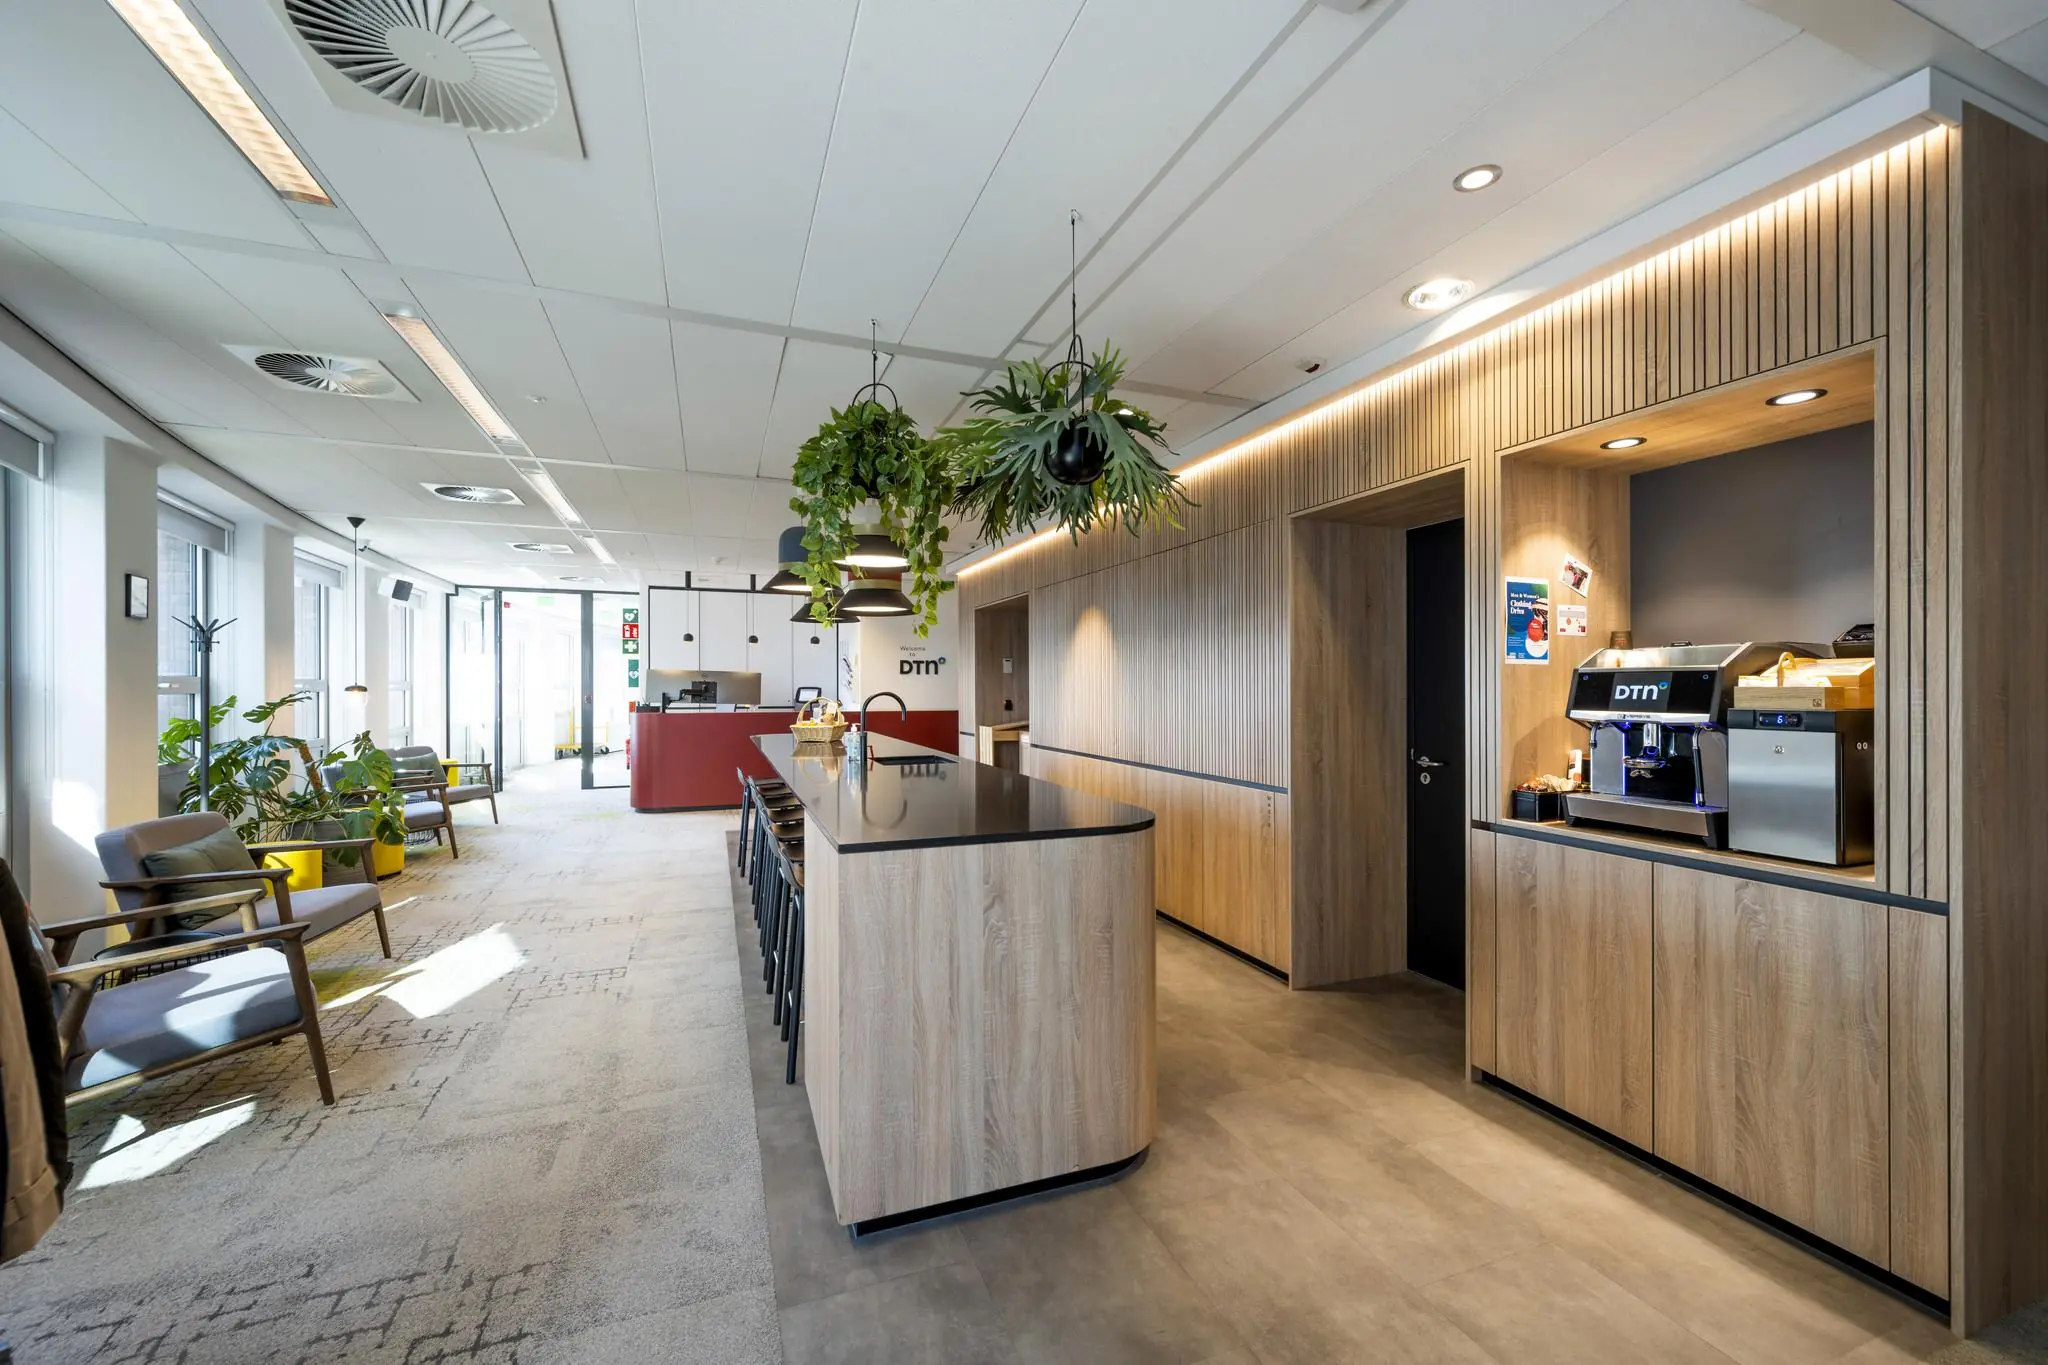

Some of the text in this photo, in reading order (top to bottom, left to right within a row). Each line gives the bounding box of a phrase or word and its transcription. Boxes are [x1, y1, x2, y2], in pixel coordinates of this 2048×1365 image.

[1510, 600, 1532, 609] Clothing
[1510, 607, 1525, 615] Drive
[1777, 715, 1783, 724] 6
